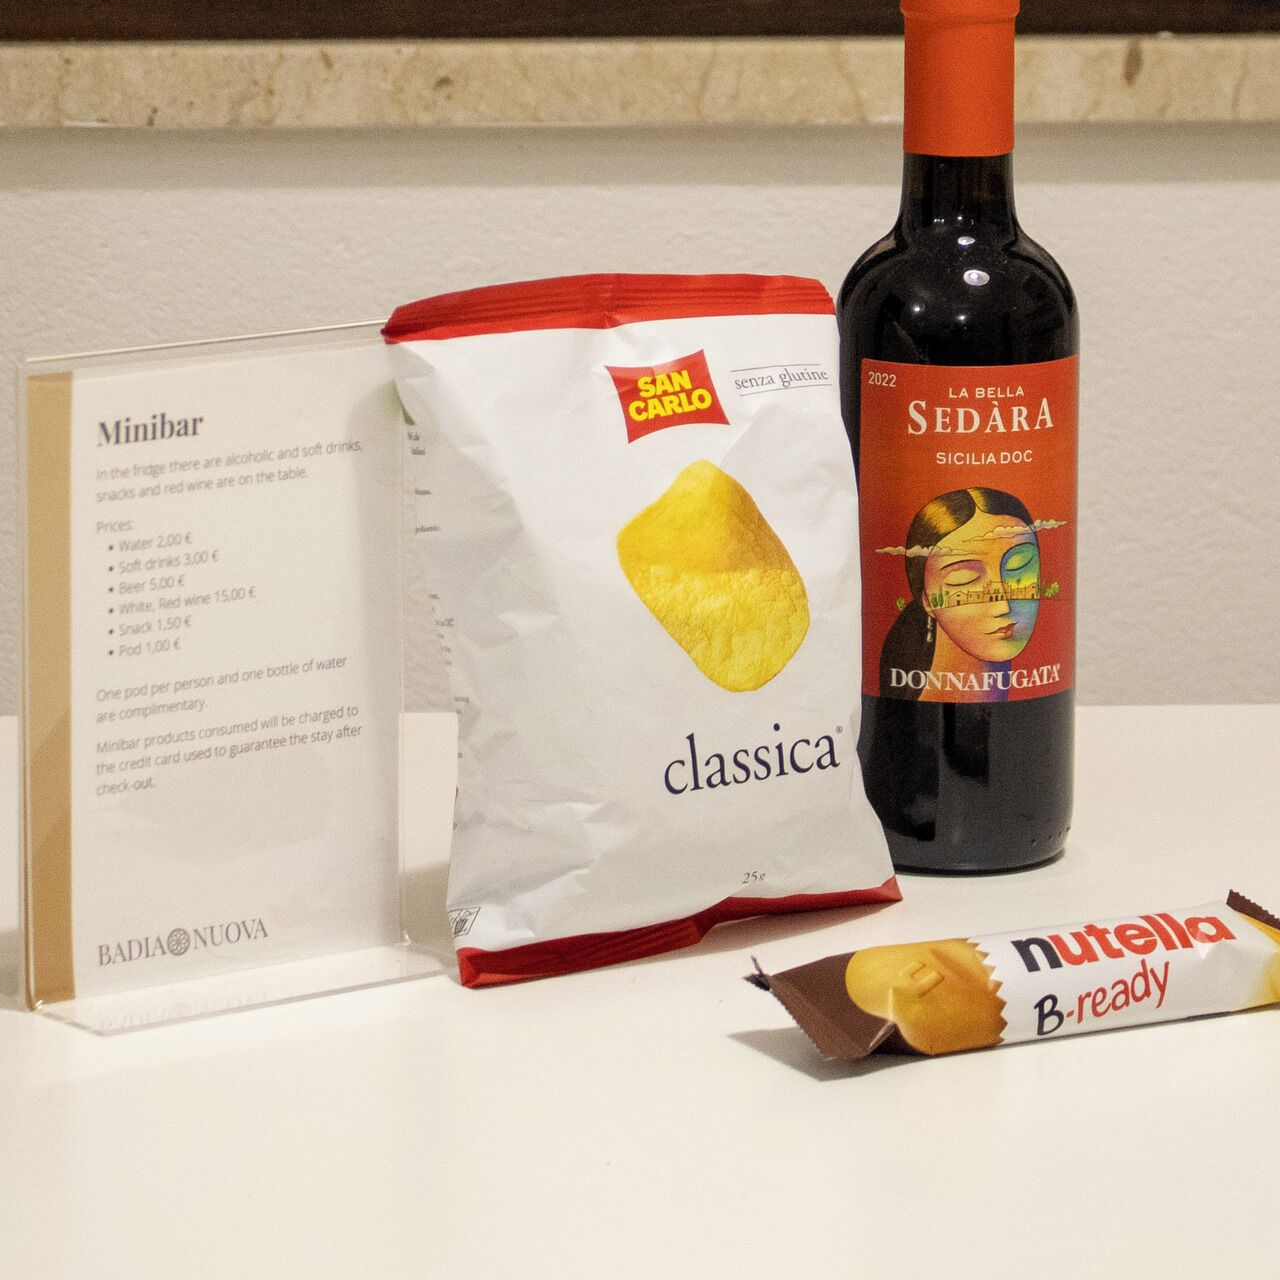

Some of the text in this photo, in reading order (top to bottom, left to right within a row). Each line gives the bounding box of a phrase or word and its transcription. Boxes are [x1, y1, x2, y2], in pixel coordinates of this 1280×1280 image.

[637, 370, 692, 398] SAN
[734, 367, 829, 390] senza glutine
[869, 372, 897, 387] 2022
[949, 386, 1025, 398] LA BELLA
[628, 388, 712, 421] CARLO
[907, 397, 1055, 435] SEDÀRA
[97, 412, 204, 447] Minibar
[96, 469, 108, 481] In
[111, 465, 129, 478] the
[132, 461, 166, 478] fridge
[170, 458, 200, 472] there
[203, 455, 222, 468] are
[225, 448, 273, 466] alcoholic
[277, 446, 299, 460] and
[303, 442, 322, 457] soft
[936, 450, 1033, 465] SICILIA DOC
[96, 466, 308, 502] snacks and red wine are on the table.
[119, 538, 153, 551] Water
[184, 531, 193, 545] €
[119, 558, 141, 573] Soft
[145, 554, 181, 570] drinks
[211, 549, 220, 562] €
[119, 580, 145, 594] Beer
[177, 574, 185, 587] €
[159, 597, 181, 610] Red
[184, 593, 211, 606] wine
[248, 585, 257, 598] €
[119, 621, 153, 636] Snack
[184, 614, 193, 628] €
[119, 642, 142, 657] Pod
[173, 636, 182, 650] €
[96, 656, 348, 702] One pod per person and one bottle of water
[96, 699, 208, 723] are complimentary.
[96, 706, 359, 753] Minibar products consumed will be charged to
[96, 724, 363, 775] the credit card used to guarantee the stay after
[664, 723, 841, 795] classica
[99, 917, 268, 966] BADIA NUOVA
[1010, 912, 1236, 973] nutella
[1033, 958, 1171, 1036] B-ready
